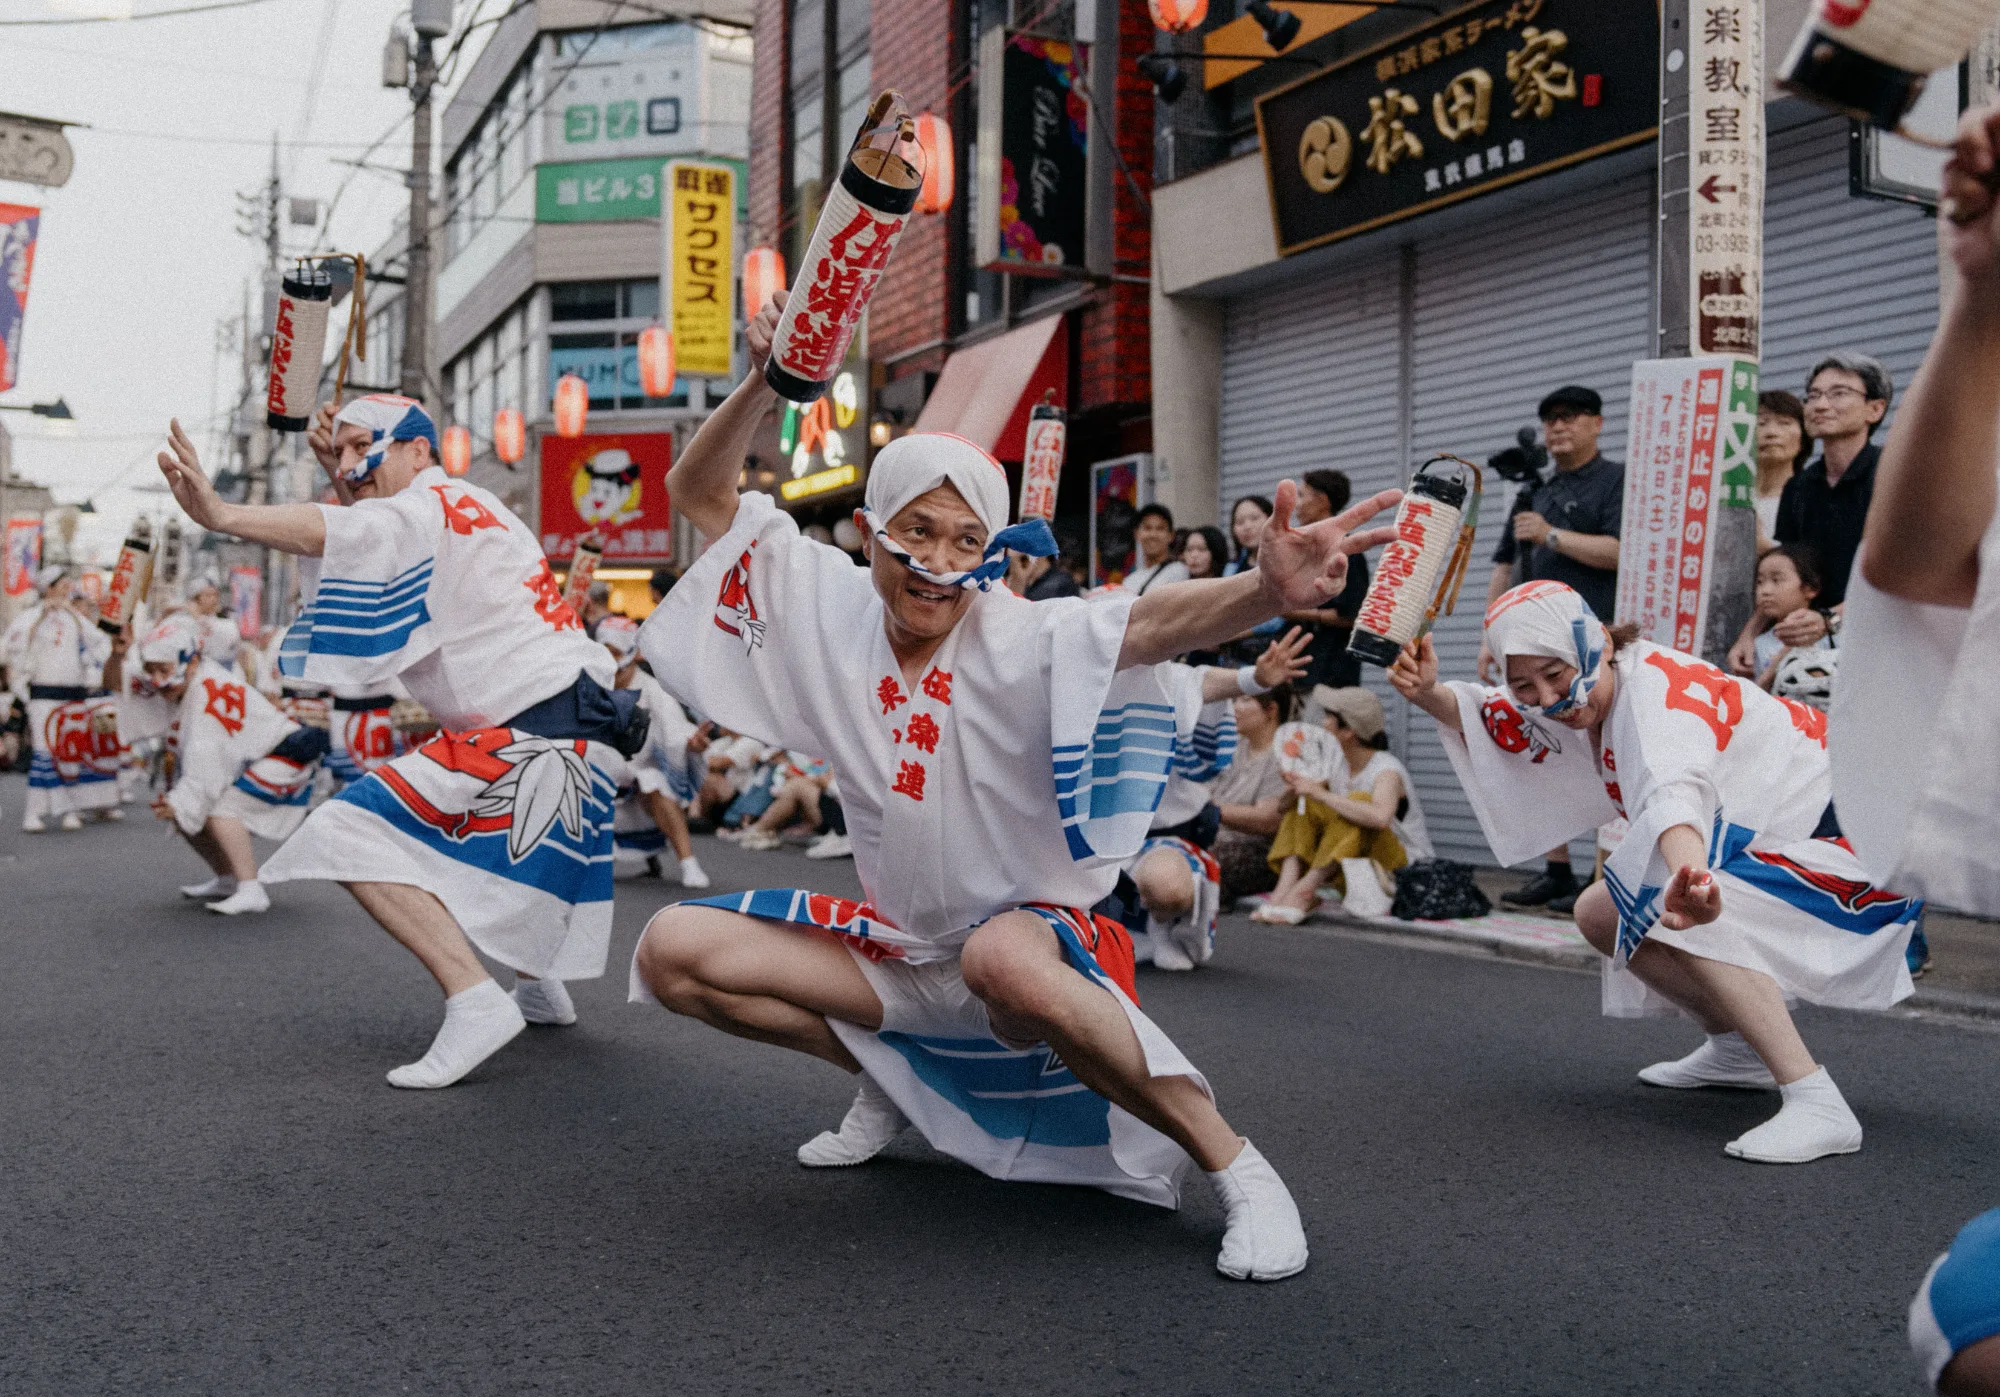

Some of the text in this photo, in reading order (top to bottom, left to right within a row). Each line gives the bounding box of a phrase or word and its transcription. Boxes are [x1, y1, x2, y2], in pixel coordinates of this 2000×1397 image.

[1359, 25, 1577, 174] 松田家
[686, 200, 718, 303] サクセス
